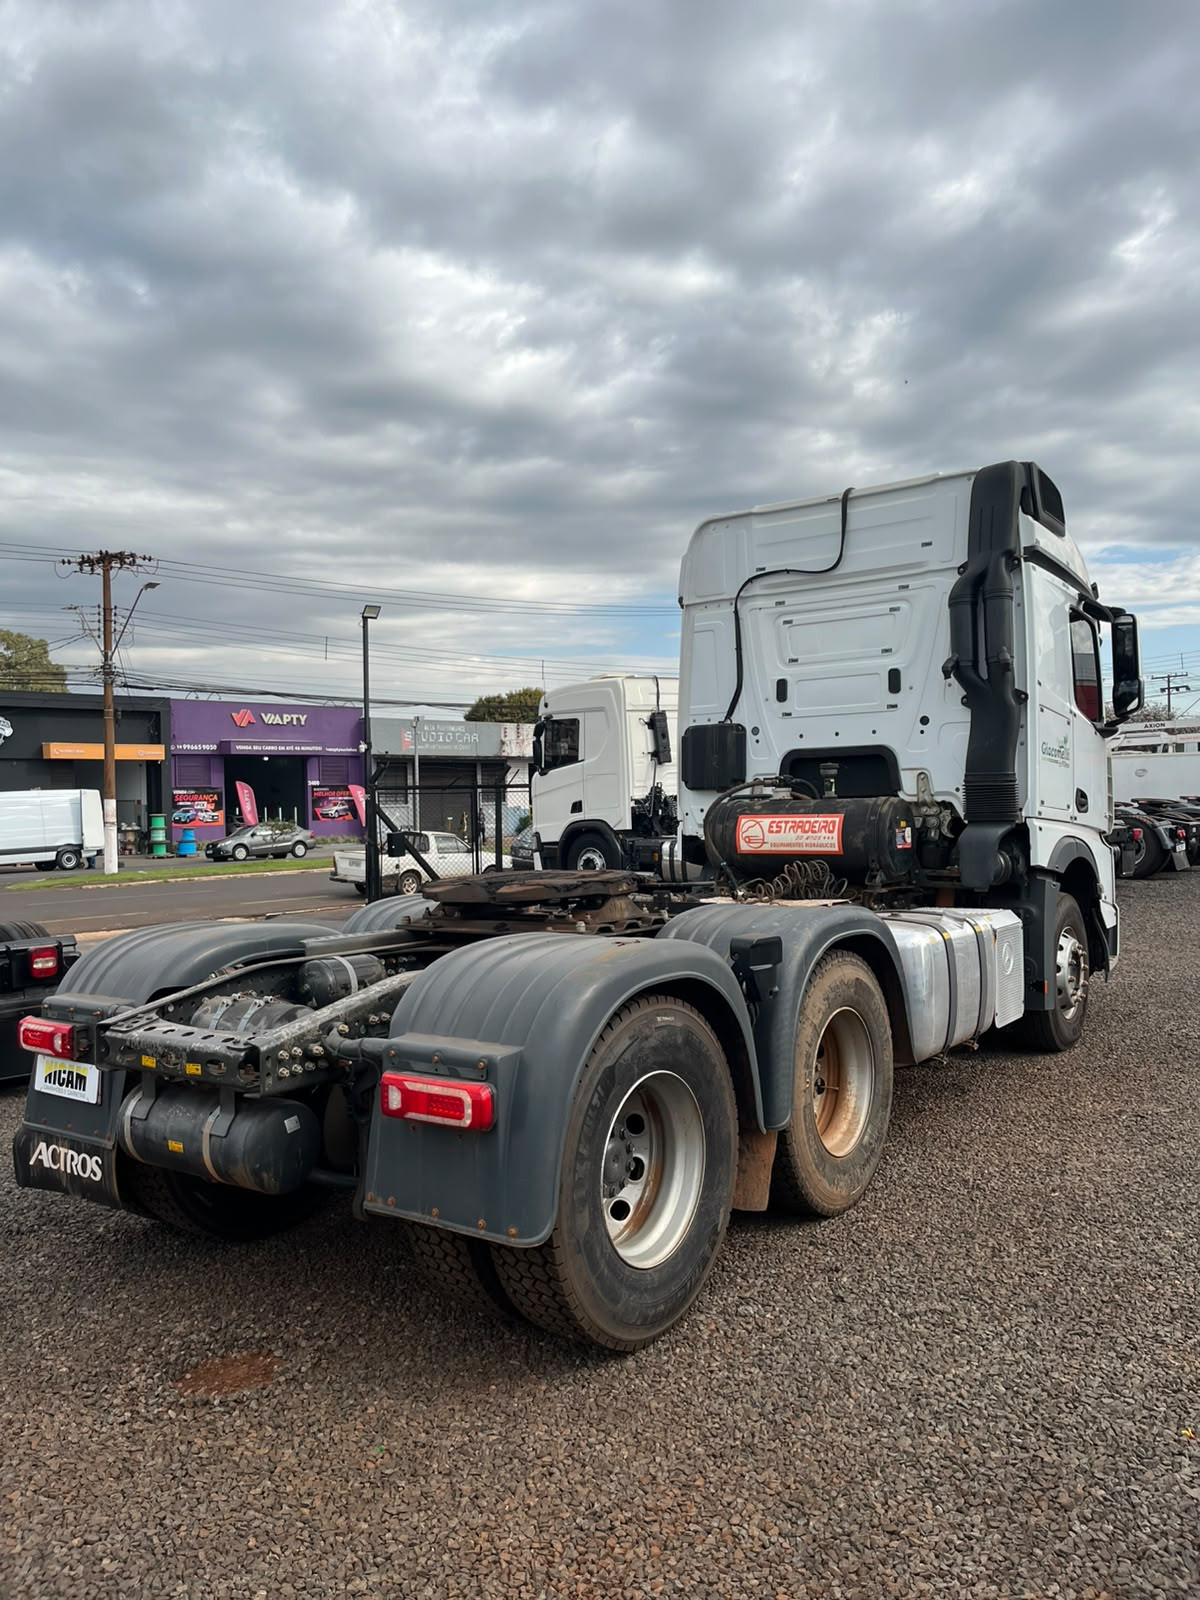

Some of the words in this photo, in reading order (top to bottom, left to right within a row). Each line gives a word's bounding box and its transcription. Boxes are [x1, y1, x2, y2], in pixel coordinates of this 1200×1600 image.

[174, 794, 218, 803] SEGURANÇA
[767, 820, 837, 834] ESTRADEIRO
[28, 1141, 103, 1182] ACTROS
